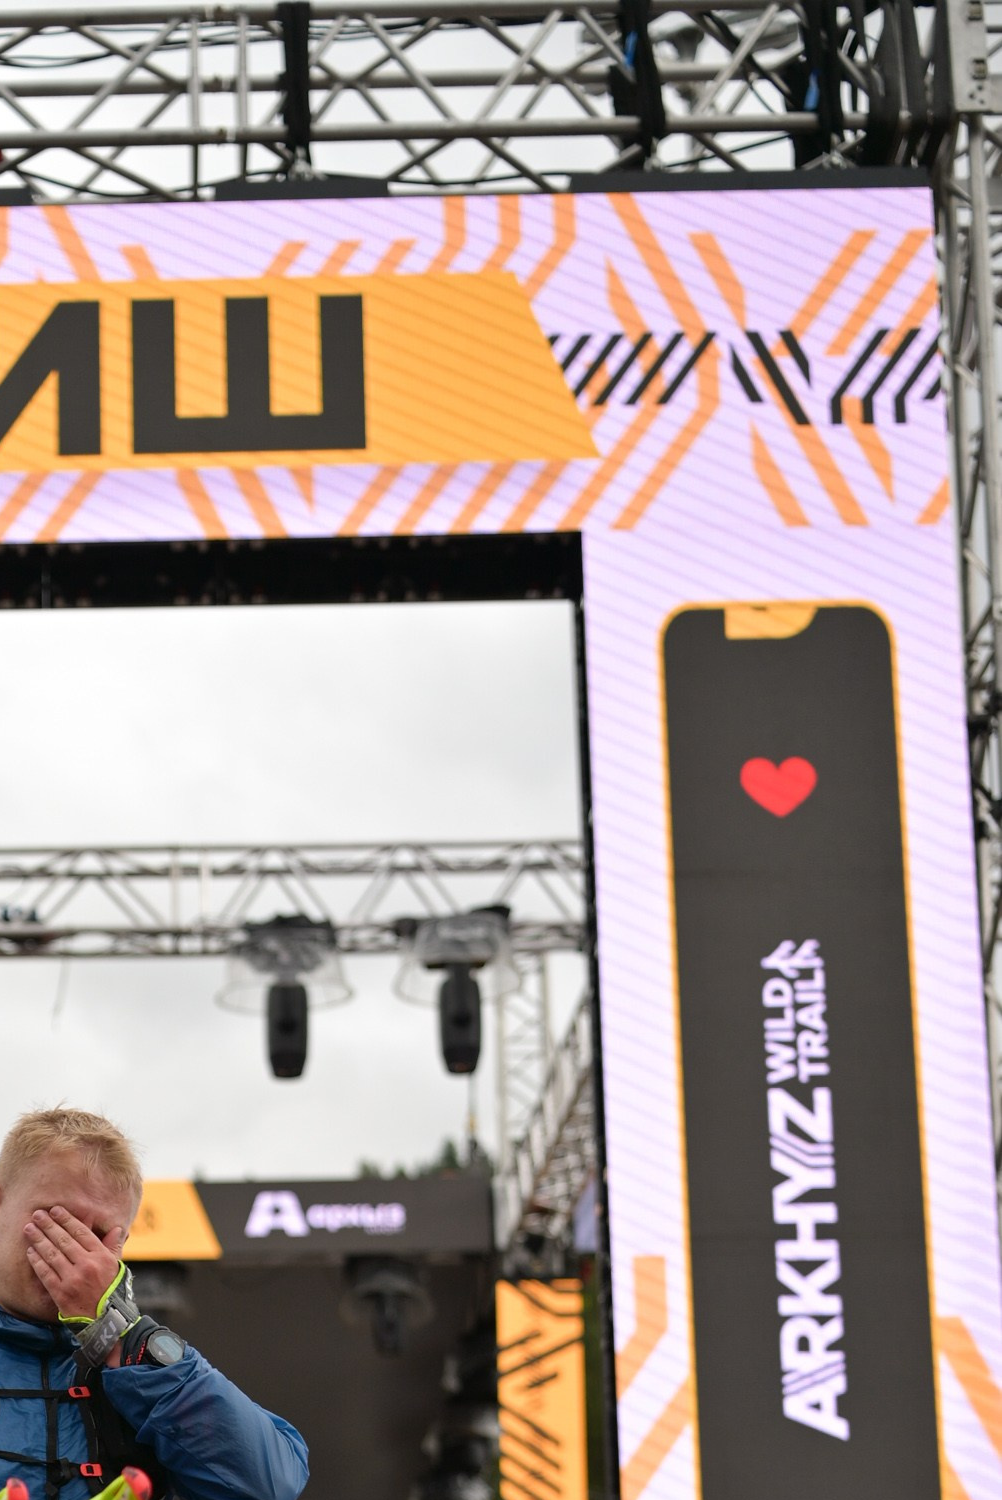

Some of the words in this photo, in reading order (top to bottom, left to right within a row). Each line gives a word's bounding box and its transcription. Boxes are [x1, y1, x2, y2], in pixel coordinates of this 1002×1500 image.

[761, 977, 797, 1084] WILD
[766, 1086, 850, 1441] ARKHYZ
[86, 1320, 118, 1361] LEKI
